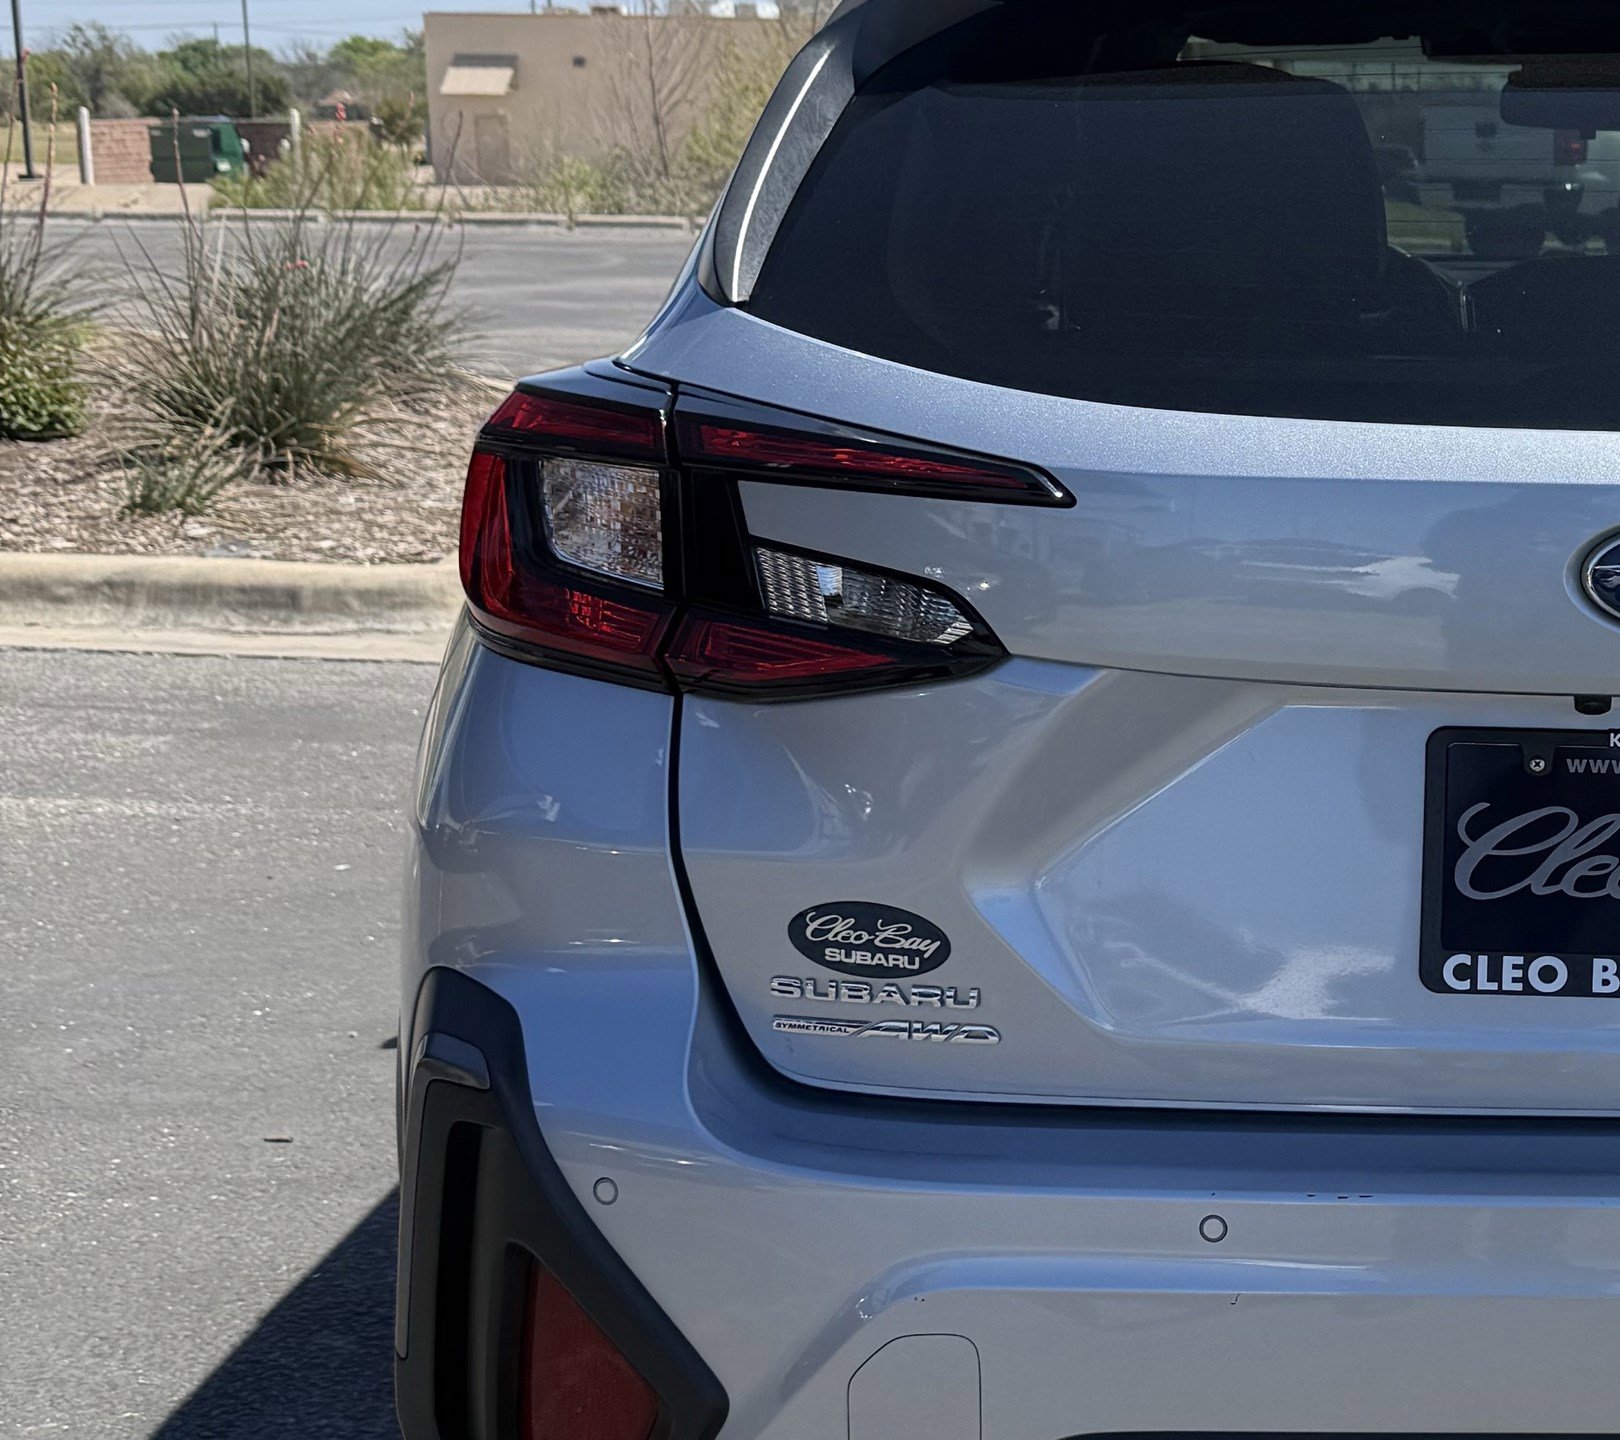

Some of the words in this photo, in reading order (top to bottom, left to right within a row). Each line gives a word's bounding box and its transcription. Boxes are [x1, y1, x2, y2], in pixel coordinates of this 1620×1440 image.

[805, 911, 875, 945] Cleo
[873, 919, 941, 959] Bay
[824, 947, 920, 970] SUBARU
[1441, 953, 1569, 992] CLEO
[770, 975, 982, 1009] SUBARU
[775, 1021, 850, 1034] SYMMETRICAL
[856, 1019, 1002, 1045] AWD
